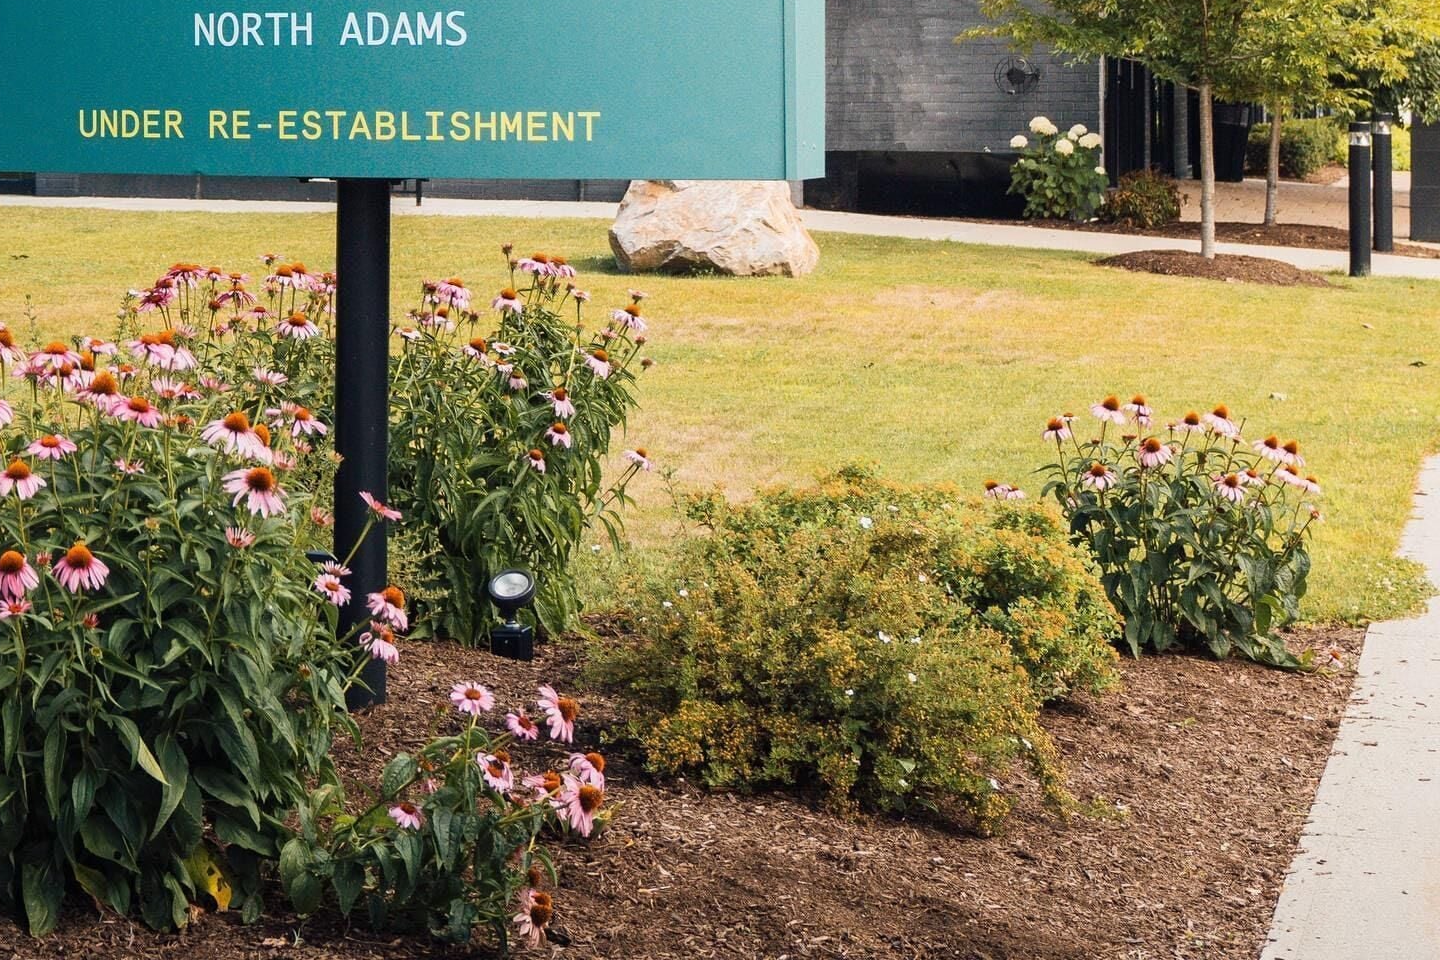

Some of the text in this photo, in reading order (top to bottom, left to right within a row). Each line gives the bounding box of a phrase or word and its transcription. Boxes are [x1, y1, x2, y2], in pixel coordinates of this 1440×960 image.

[194, 11, 468, 47] NORTH ADAMS
[79, 109, 601, 142] UNDER RE-ESTABLISHMENT
